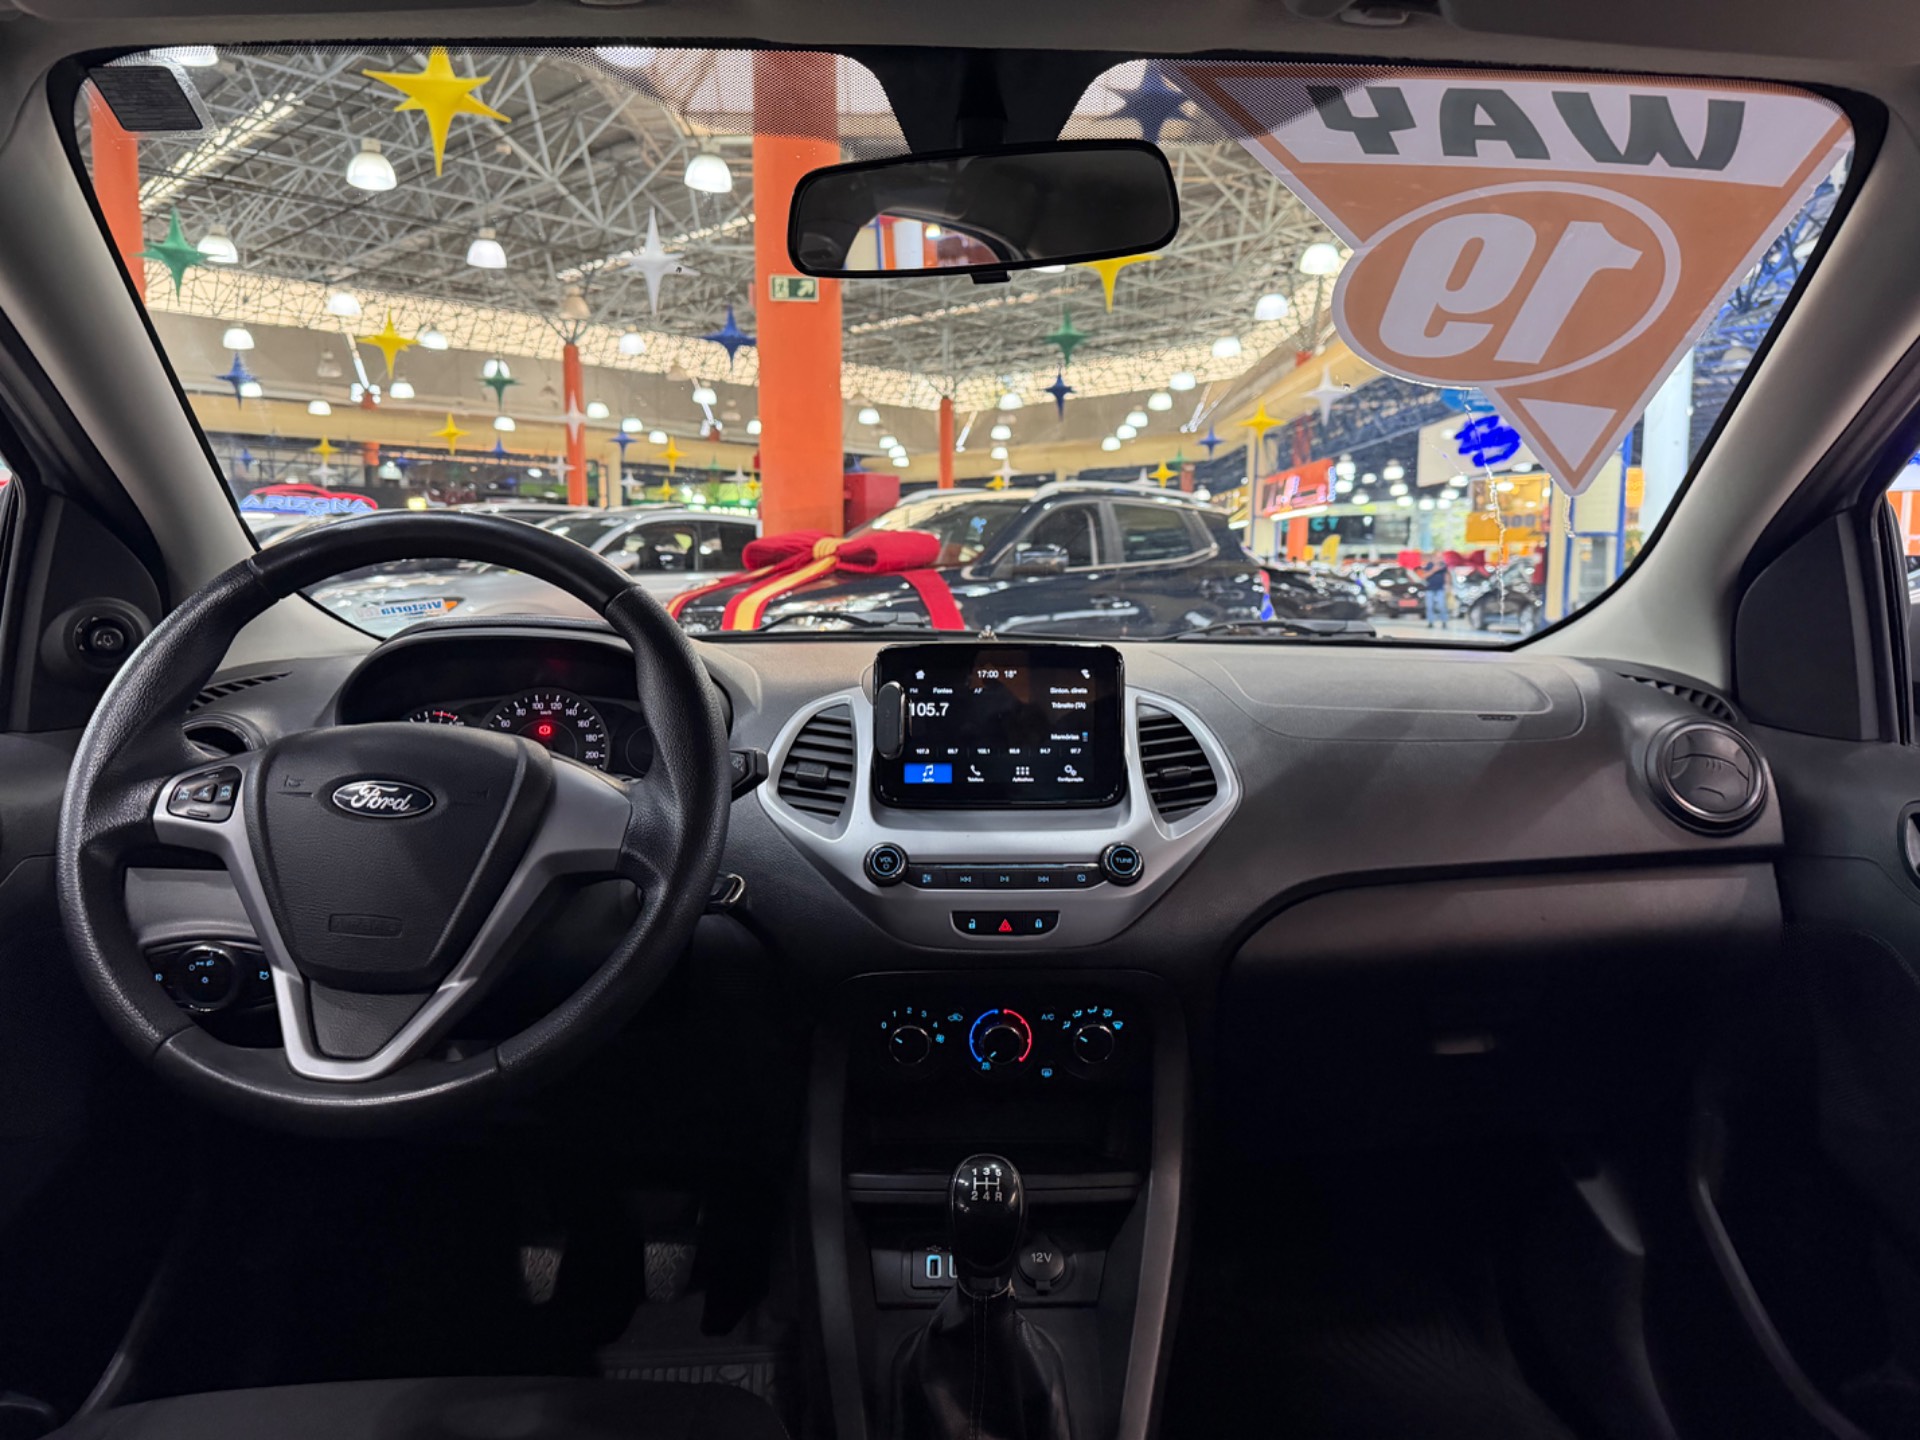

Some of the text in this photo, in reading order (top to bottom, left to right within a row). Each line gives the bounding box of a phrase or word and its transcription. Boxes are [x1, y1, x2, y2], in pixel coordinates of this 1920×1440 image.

[977, 669, 1000, 679] 17:00
[532, 702, 544, 710] 100
[550, 702, 562, 710] 120
[909, 702, 949, 717] 105.7
[516, 708, 526, 716] 80
[566, 709, 577, 717] 140
[500, 719, 511, 728] 60
[577, 719, 590, 728] 160
[585, 734, 598, 742] 180
[585, 751, 599, 759] 200
[351, 783, 413, 811] Ford
[983, 1167, 990, 1175] 3
[971, 1191, 1002, 1202] 2 4 R
[1031, 1253, 1052, 1263] 12V
